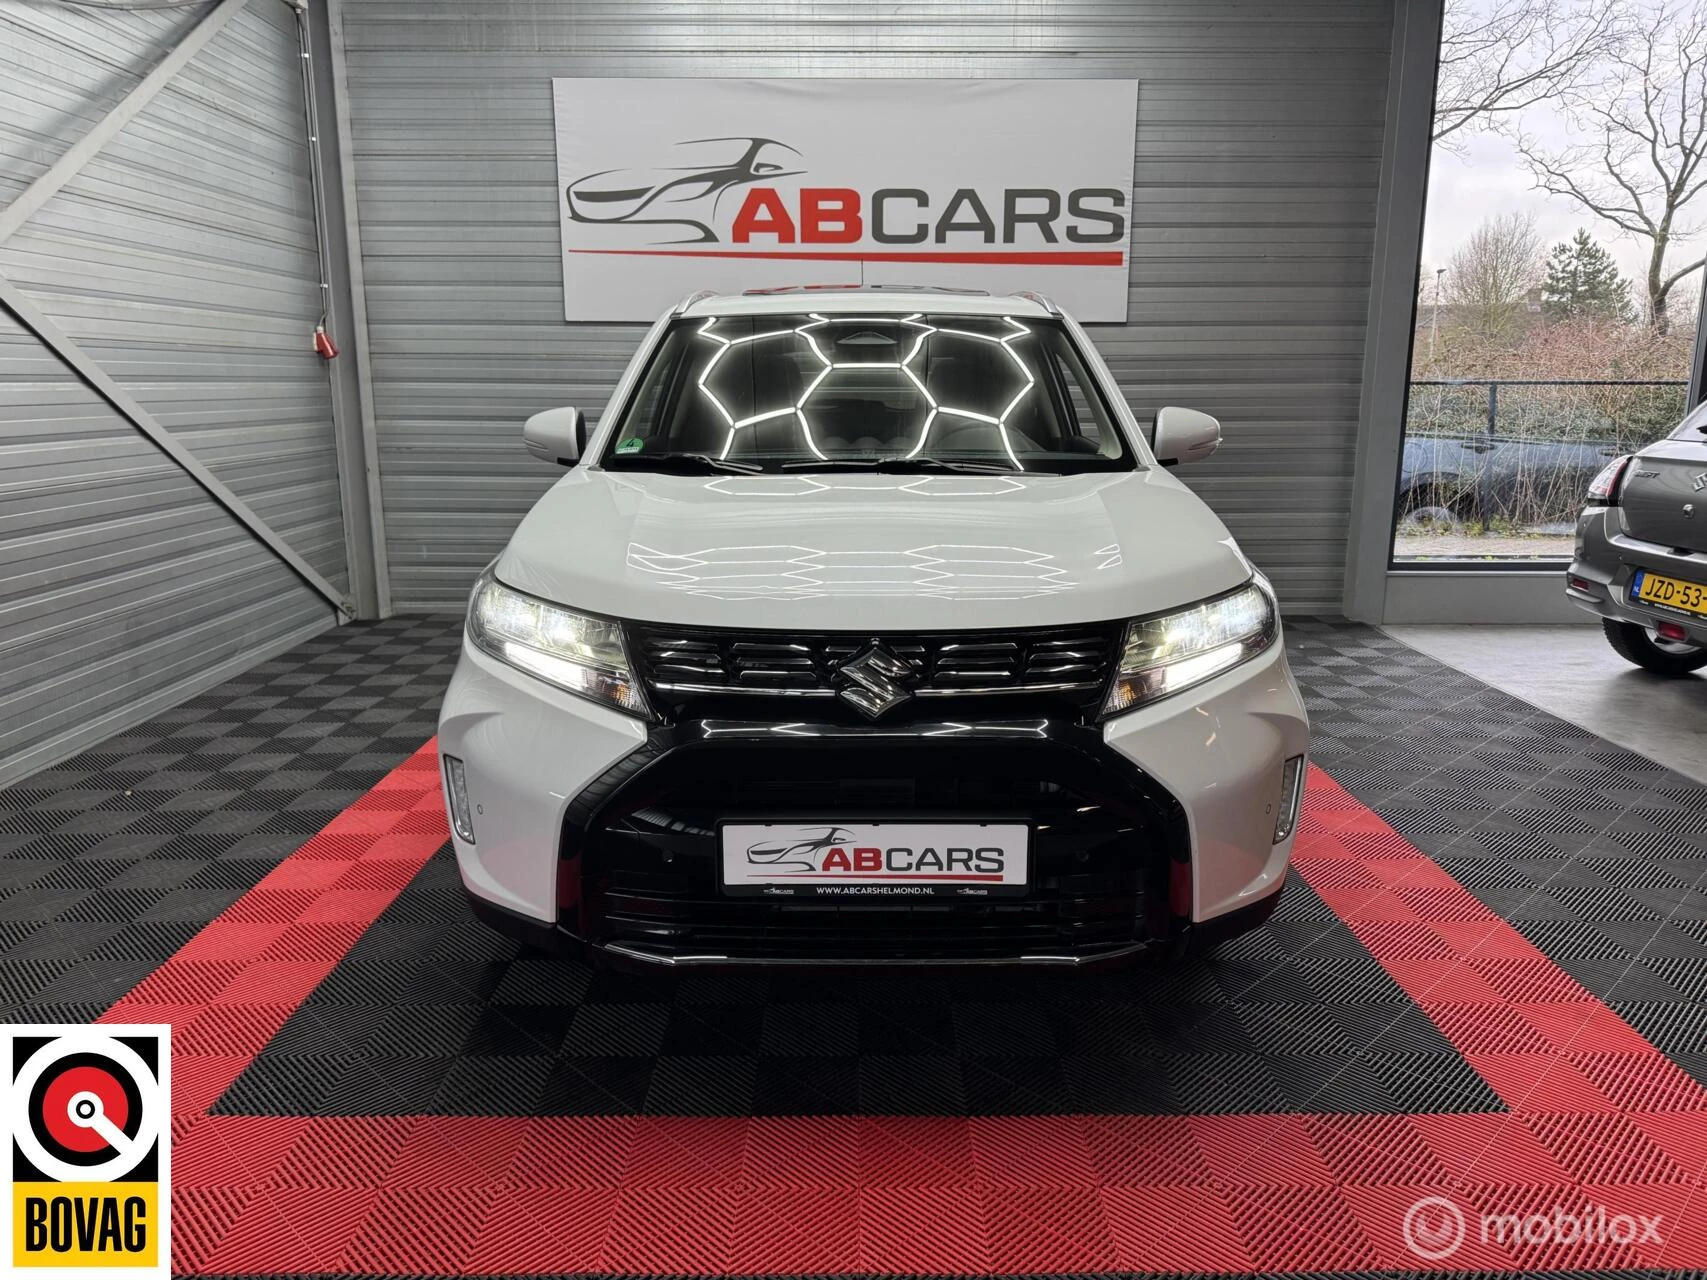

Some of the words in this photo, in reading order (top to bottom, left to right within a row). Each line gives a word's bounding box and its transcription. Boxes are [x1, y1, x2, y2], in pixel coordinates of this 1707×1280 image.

[732, 188, 1125, 244] ABCARS
[822, 847, 1004, 873] ABCARS
[816, 887, 935, 895] WWW.ABCARSHELMOND.NL
